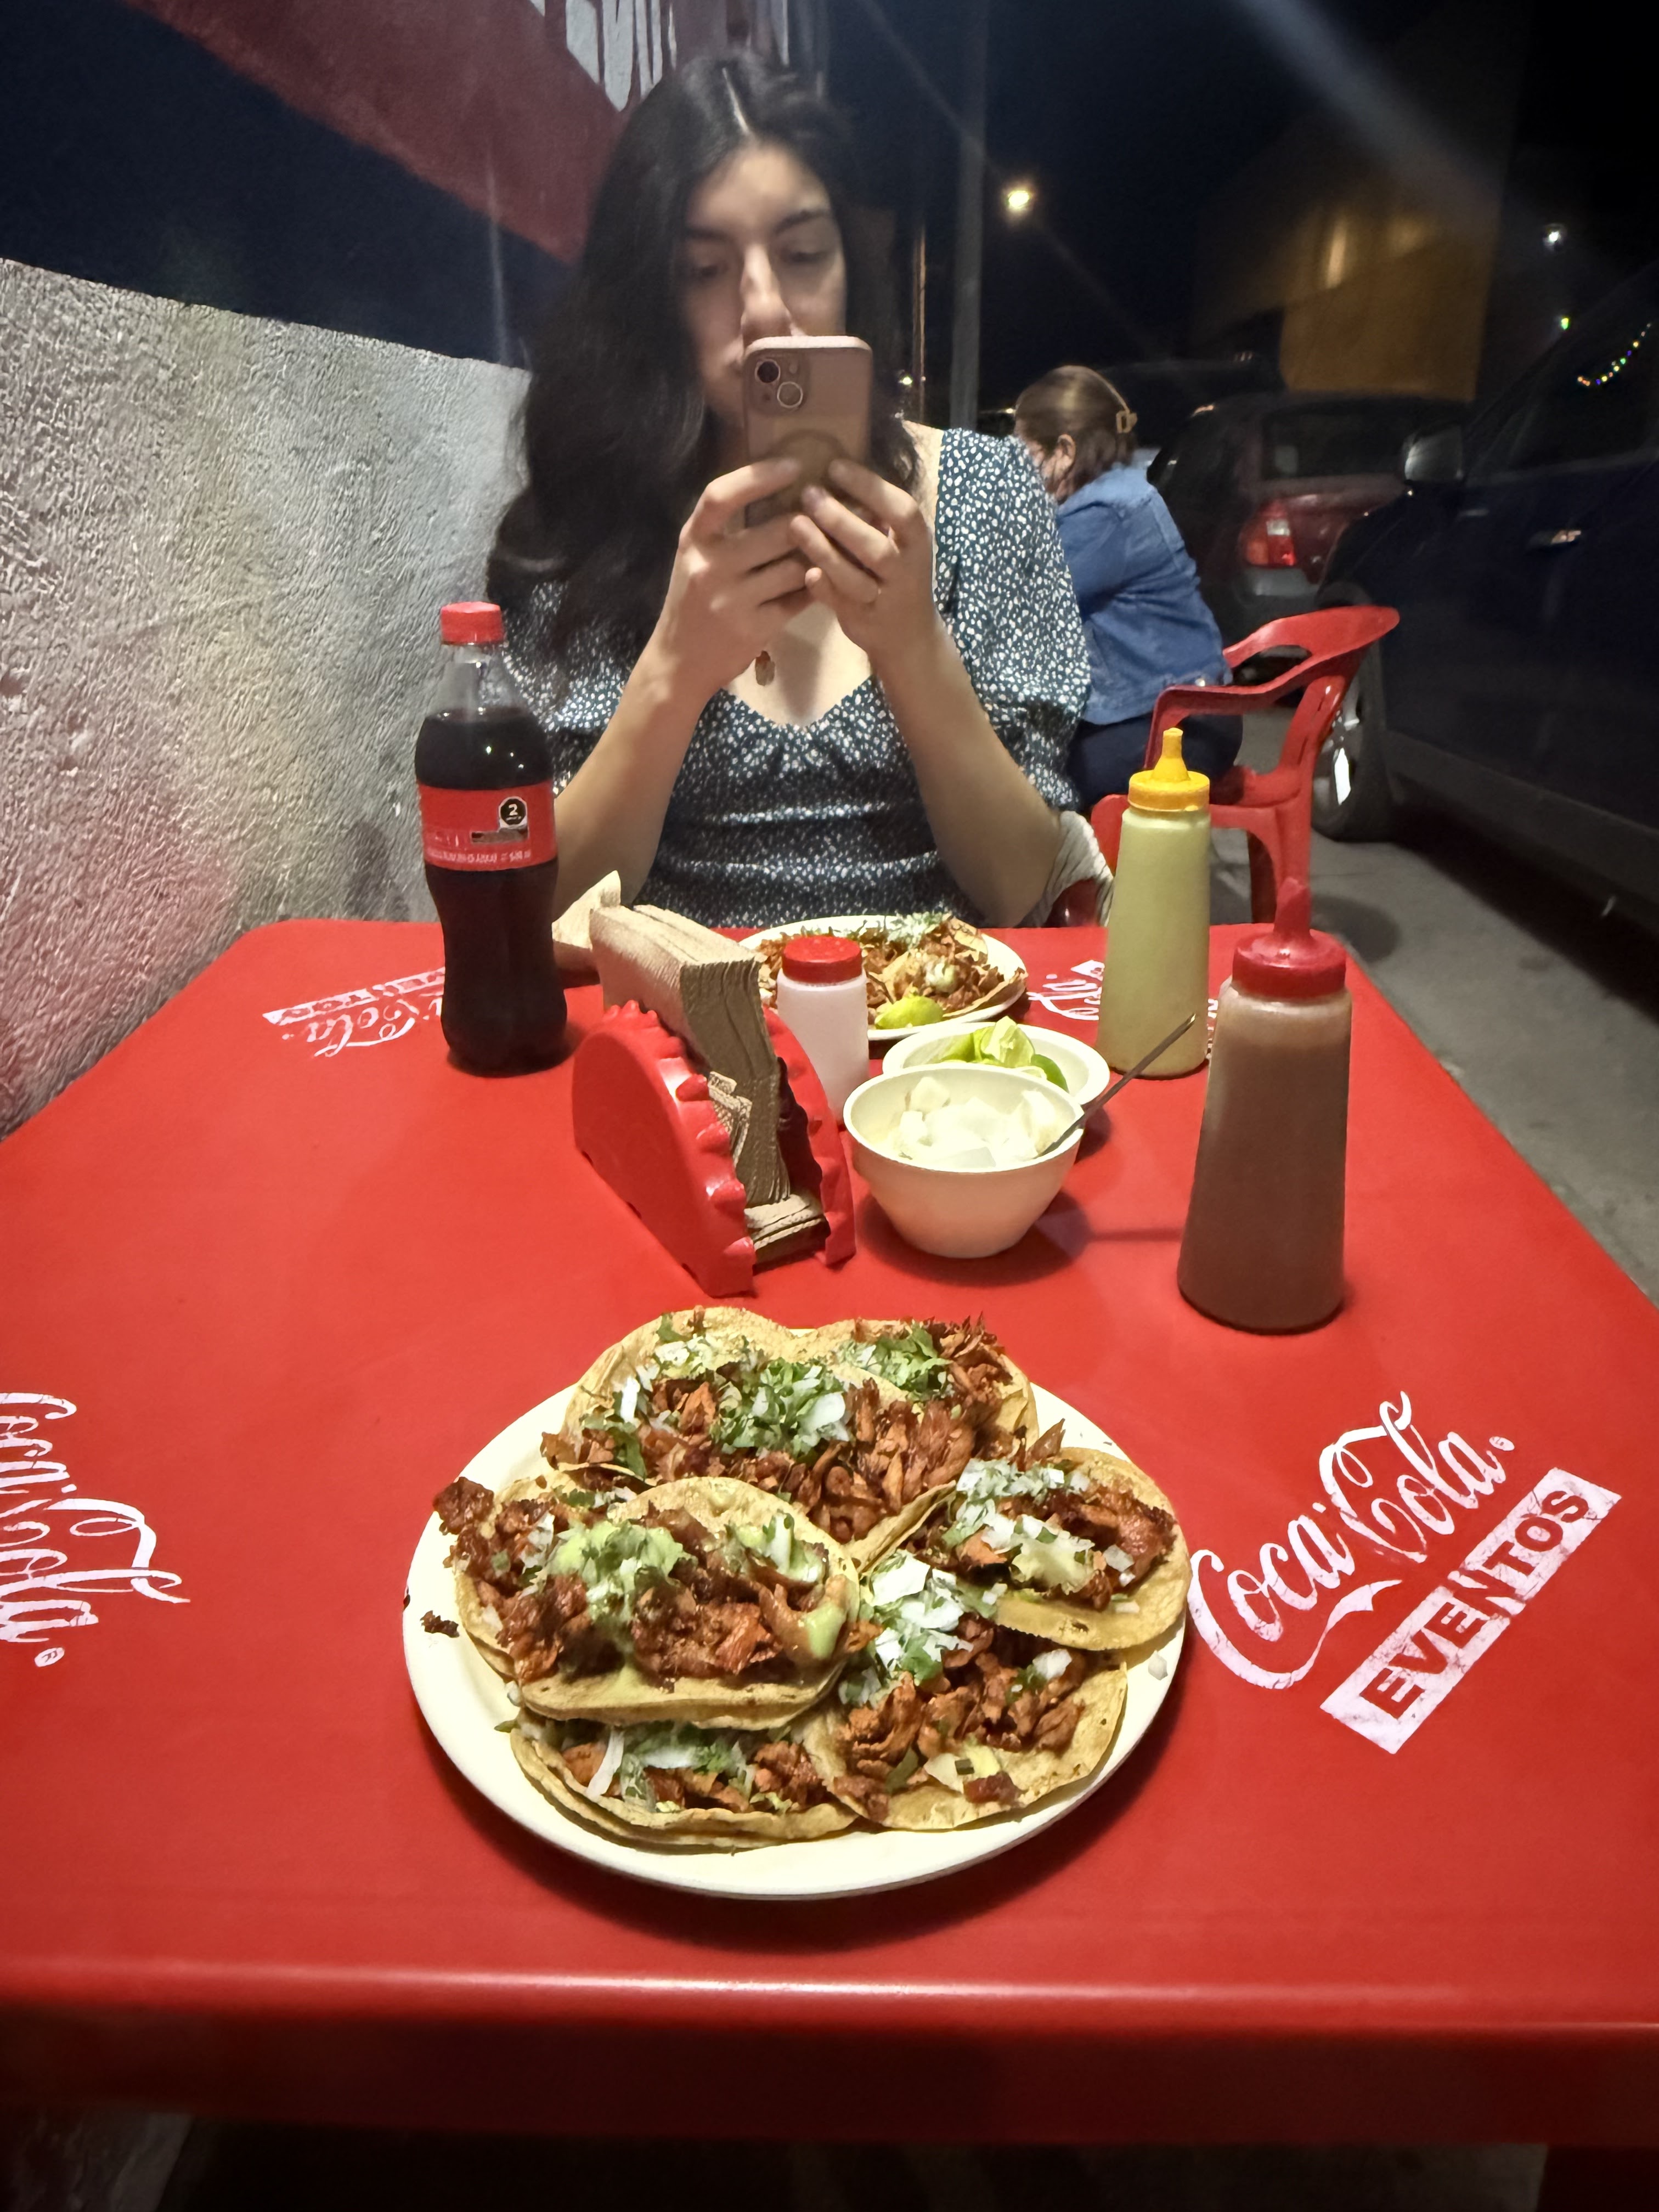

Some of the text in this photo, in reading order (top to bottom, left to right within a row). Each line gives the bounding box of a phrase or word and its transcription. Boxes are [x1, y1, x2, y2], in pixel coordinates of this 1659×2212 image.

[509, 804, 518, 816] 2
[1187, 1391, 1506, 1690] Coca-Cola
[1359, 1490, 1589, 1720] EVENTOS
